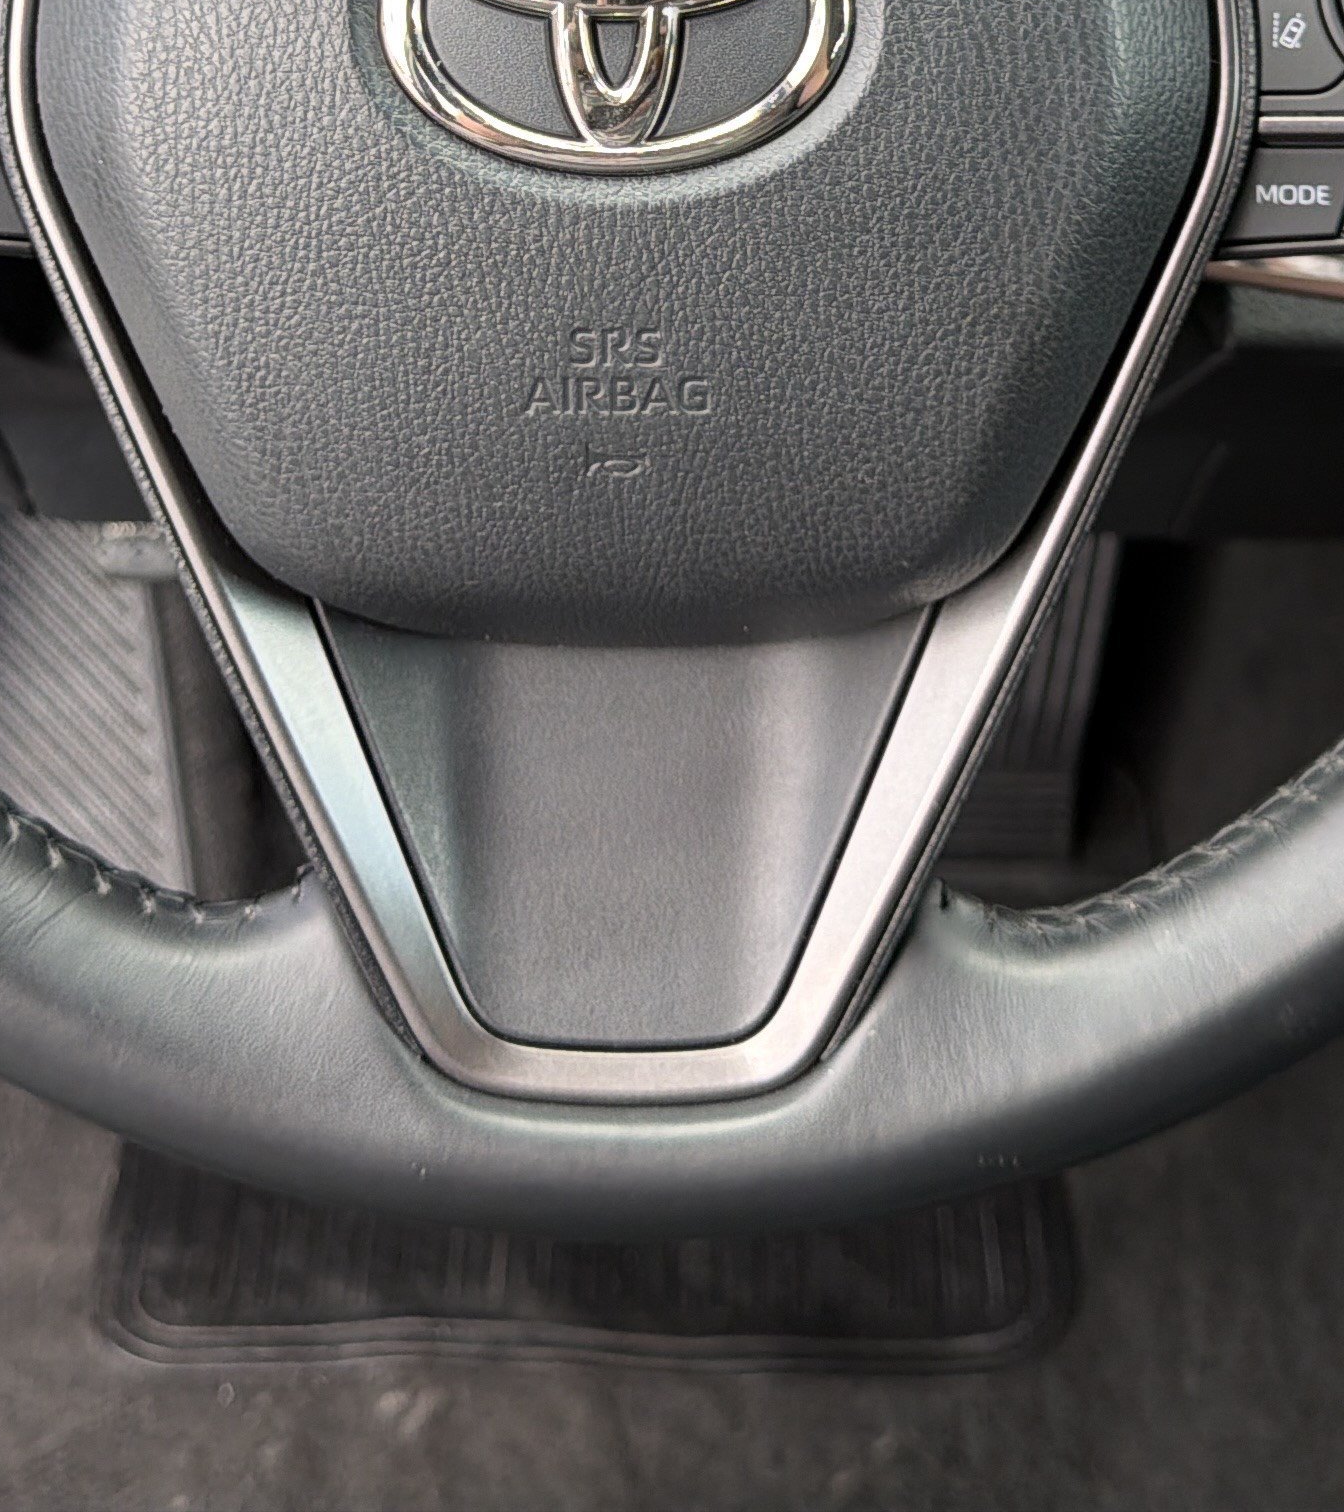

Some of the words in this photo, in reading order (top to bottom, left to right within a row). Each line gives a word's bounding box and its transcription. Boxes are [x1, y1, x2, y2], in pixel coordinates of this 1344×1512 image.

[1255, 185, 1331, 206] MODE
[569, 326, 663, 369] SRS
[524, 375, 712, 416] AIRBAG
